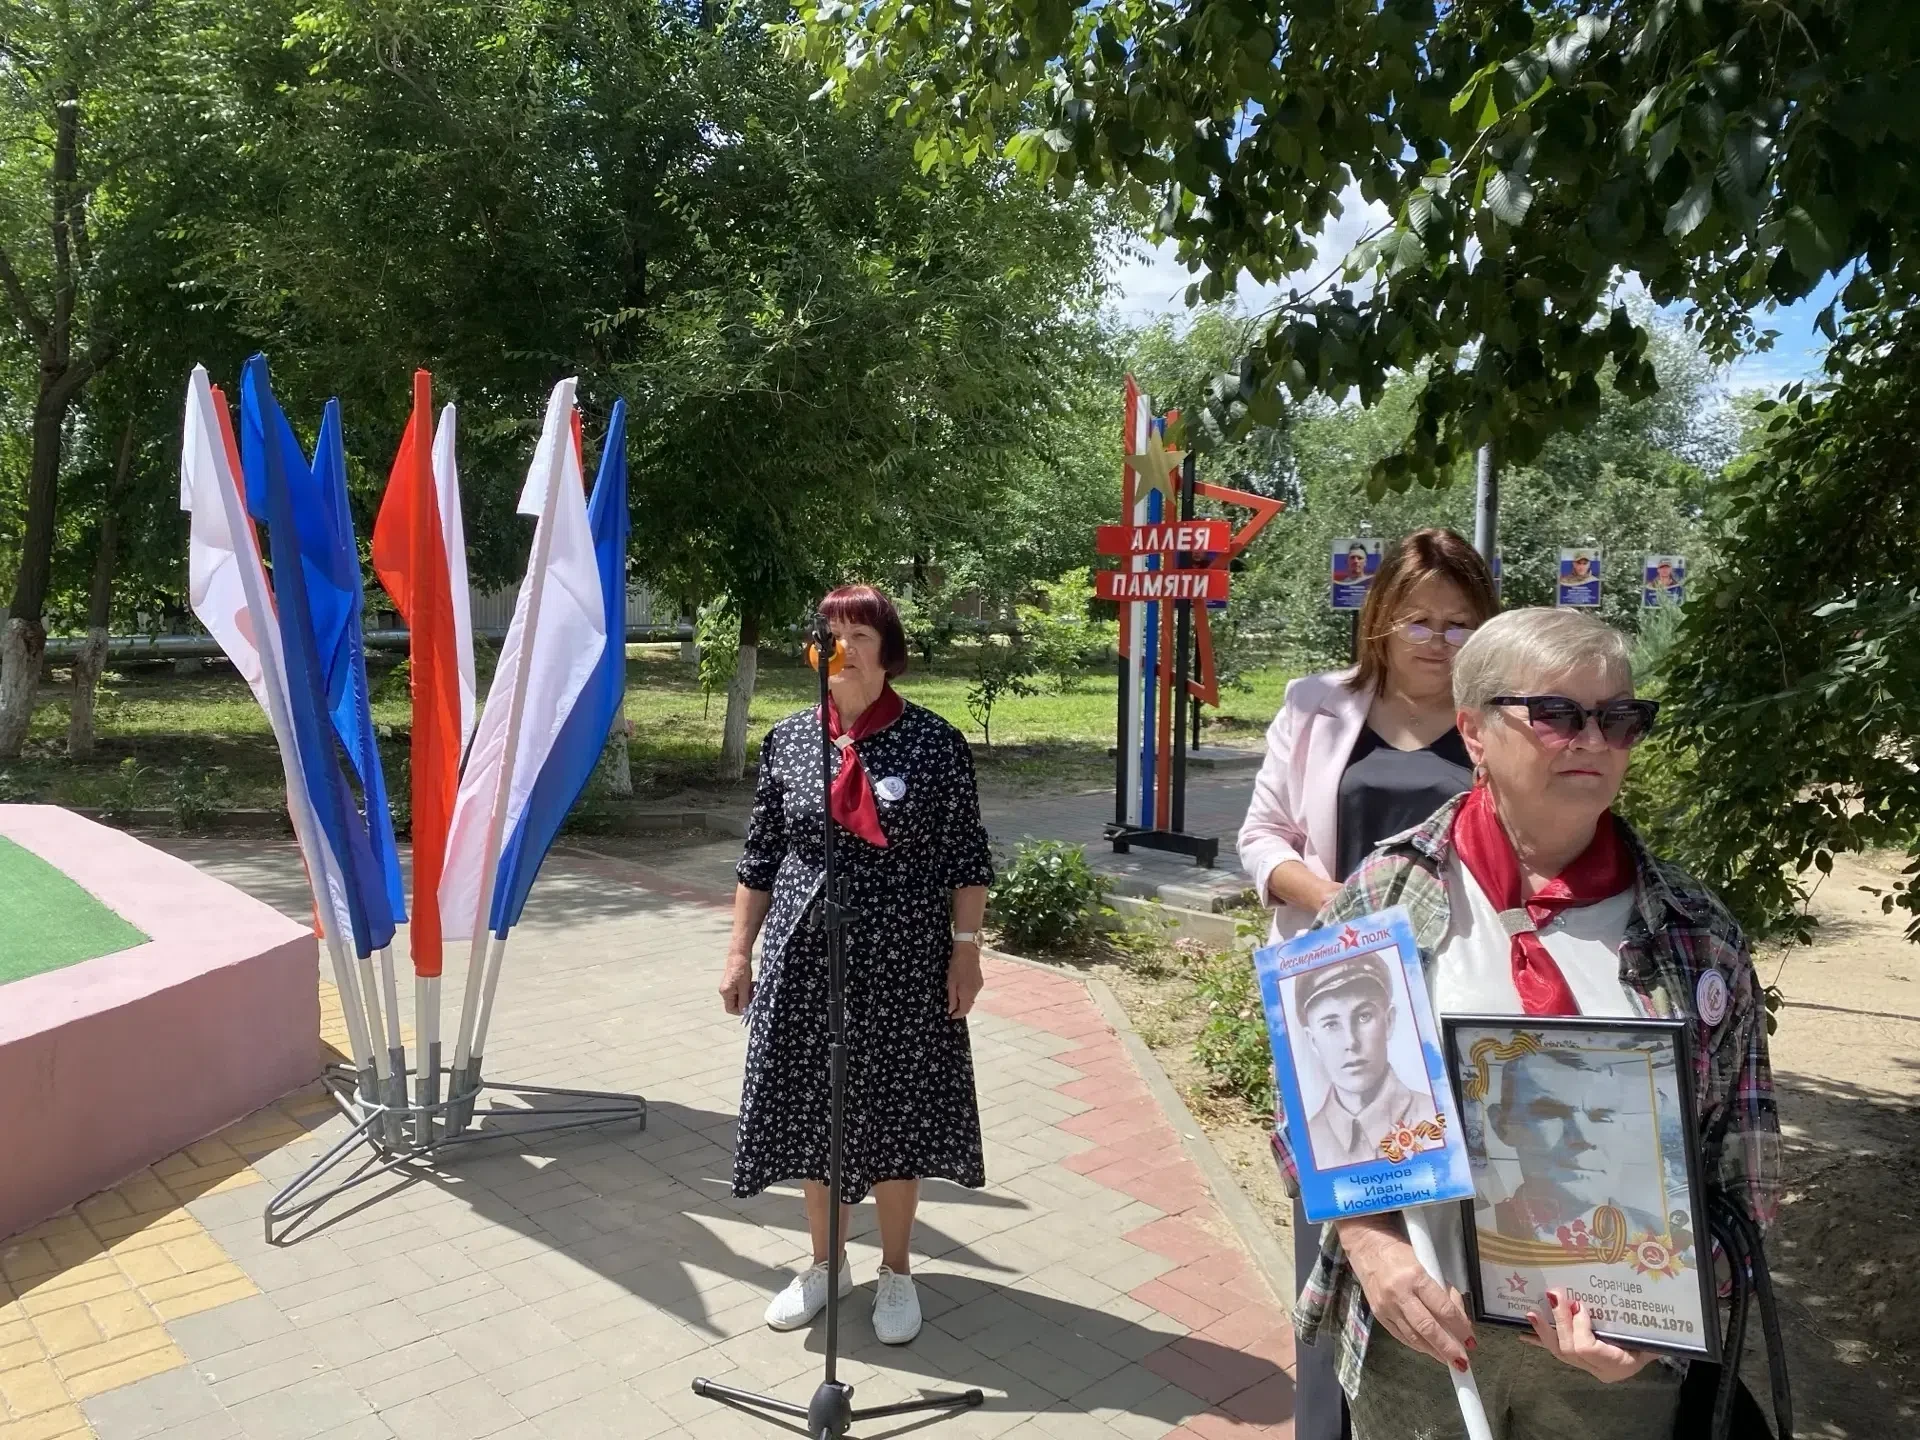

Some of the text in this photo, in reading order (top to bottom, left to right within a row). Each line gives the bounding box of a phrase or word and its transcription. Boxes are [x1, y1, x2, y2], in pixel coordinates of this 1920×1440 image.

[1131, 527, 1211, 550] АЛЛЕЯ
[1112, 574, 1209, 597] ПАМЯТИ
[1350, 1168, 1412, 1186] Чекунов
[1343, 1188, 1431, 1211] Иосифович
[1365, 1182, 1403, 1197] Иван
[1589, 1274, 1643, 1294] Саранцев
[1566, 1287, 1675, 1315] Провор Саватеевич
[1588, 1307, 1694, 1333] 1917-06.04.1979
